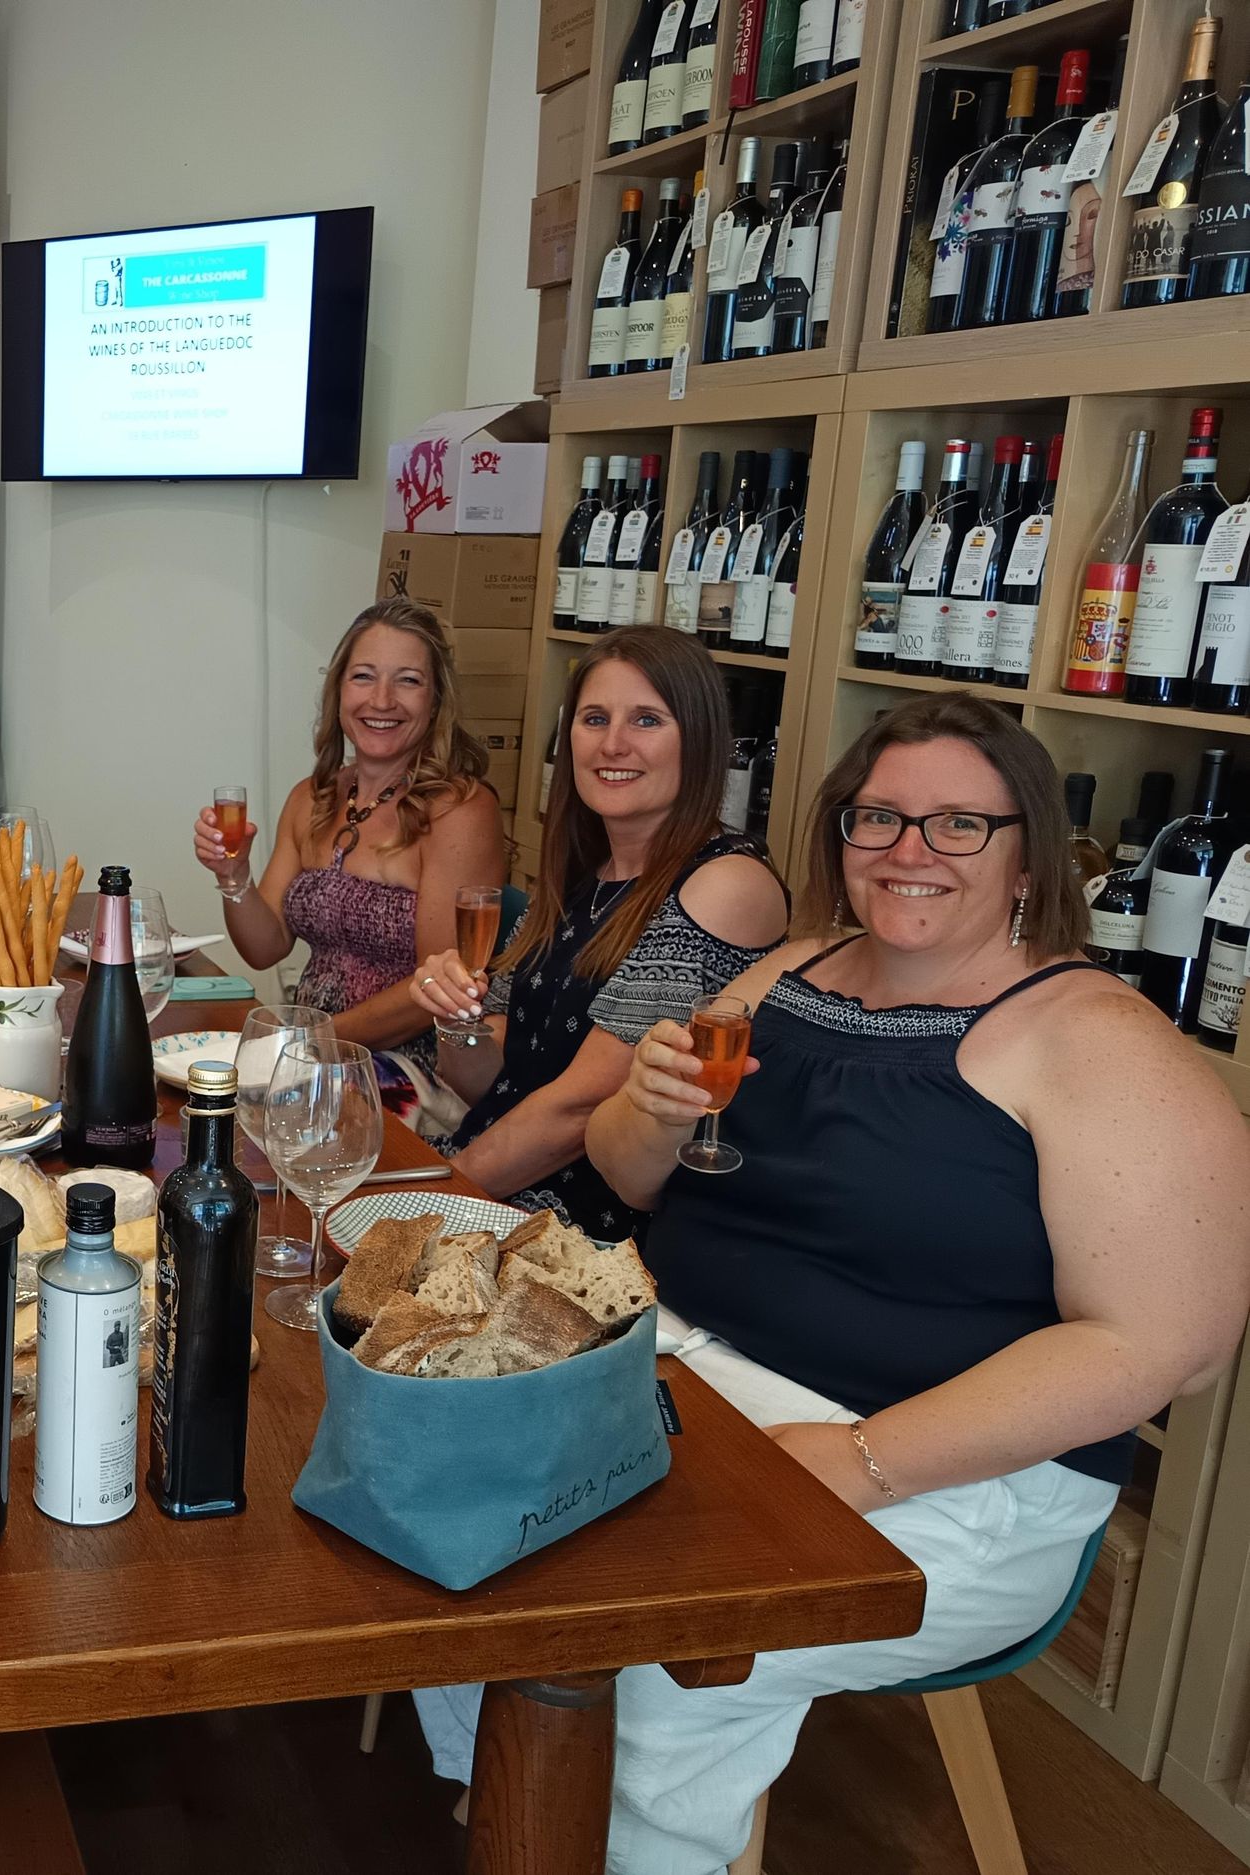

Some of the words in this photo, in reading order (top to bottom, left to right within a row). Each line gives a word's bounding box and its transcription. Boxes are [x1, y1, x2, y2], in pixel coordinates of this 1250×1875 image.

[739, 0, 755, 76] LAROUSSE
[951, 89, 976, 121] P
[1021, 215, 1049, 226] formiga
[1153, 246, 1185, 257] CASAR
[142, 275, 162, 288] THE
[165, 268, 247, 287] CARCASSONNE
[91, 323, 107, 336] AN
[111, 317, 203, 334] INTRODUCTION
[208, 315, 224, 328] TO
[229, 313, 252, 326] THE
[89, 343, 126, 357] WINES
[129, 342, 144, 355] OF
[150, 340, 170, 353] THE
[175, 336, 254, 353] LANGUEDOC
[131, 360, 206, 376] ROUSSILLON
[484, 574, 498, 583] LES
[517, 1477, 597, 1554] petits
